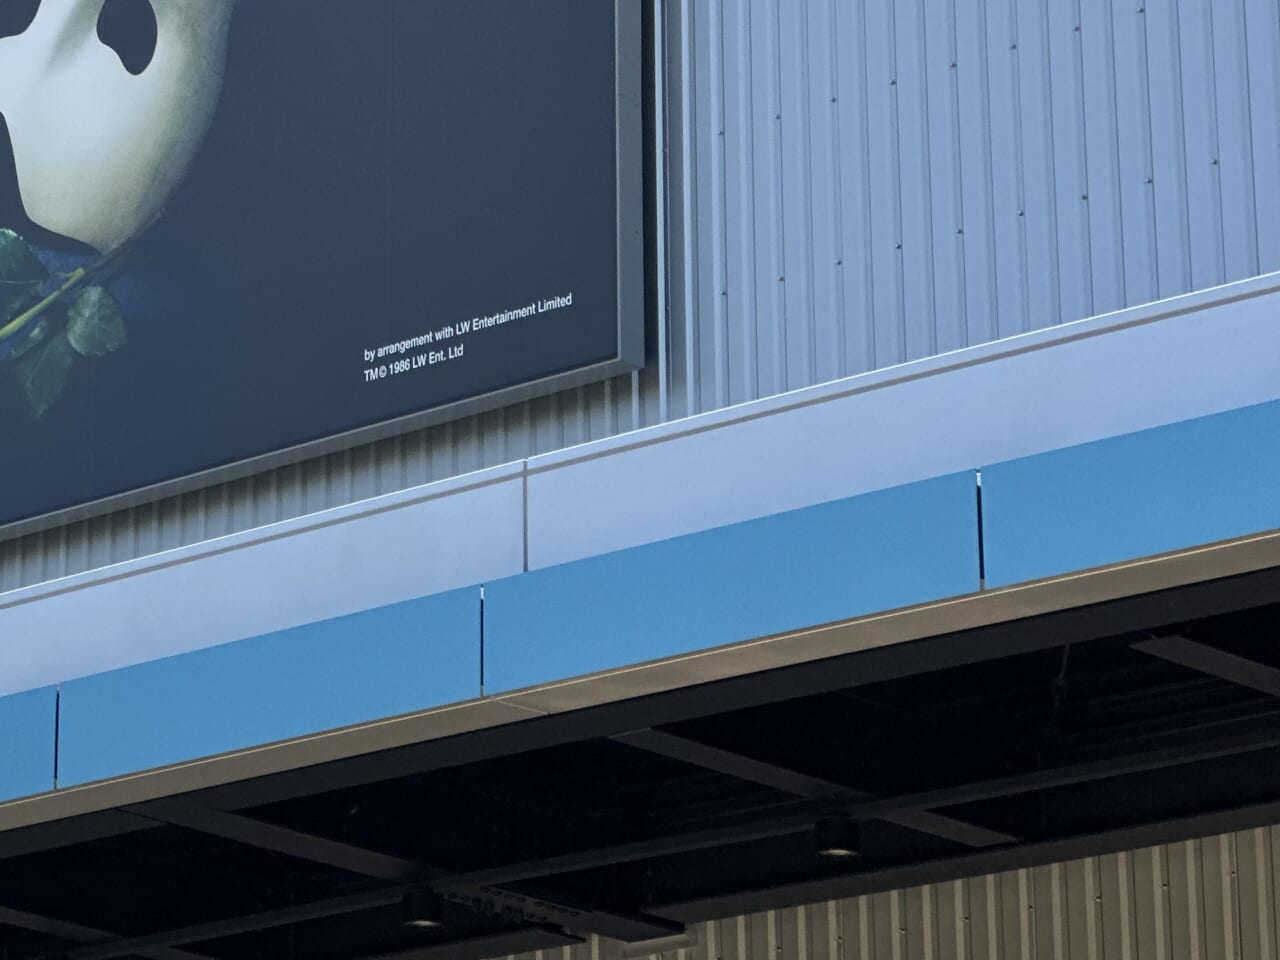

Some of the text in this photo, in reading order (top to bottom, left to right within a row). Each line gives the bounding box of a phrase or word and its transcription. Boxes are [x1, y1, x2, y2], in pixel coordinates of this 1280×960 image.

[364, 292, 573, 361] by arrangement with LW Entertainment Limited
[389, 360, 411, 376] 1986
[412, 353, 428, 369] LW
[429, 350, 448, 365] Ent.
[449, 344, 464, 359] Ltd
